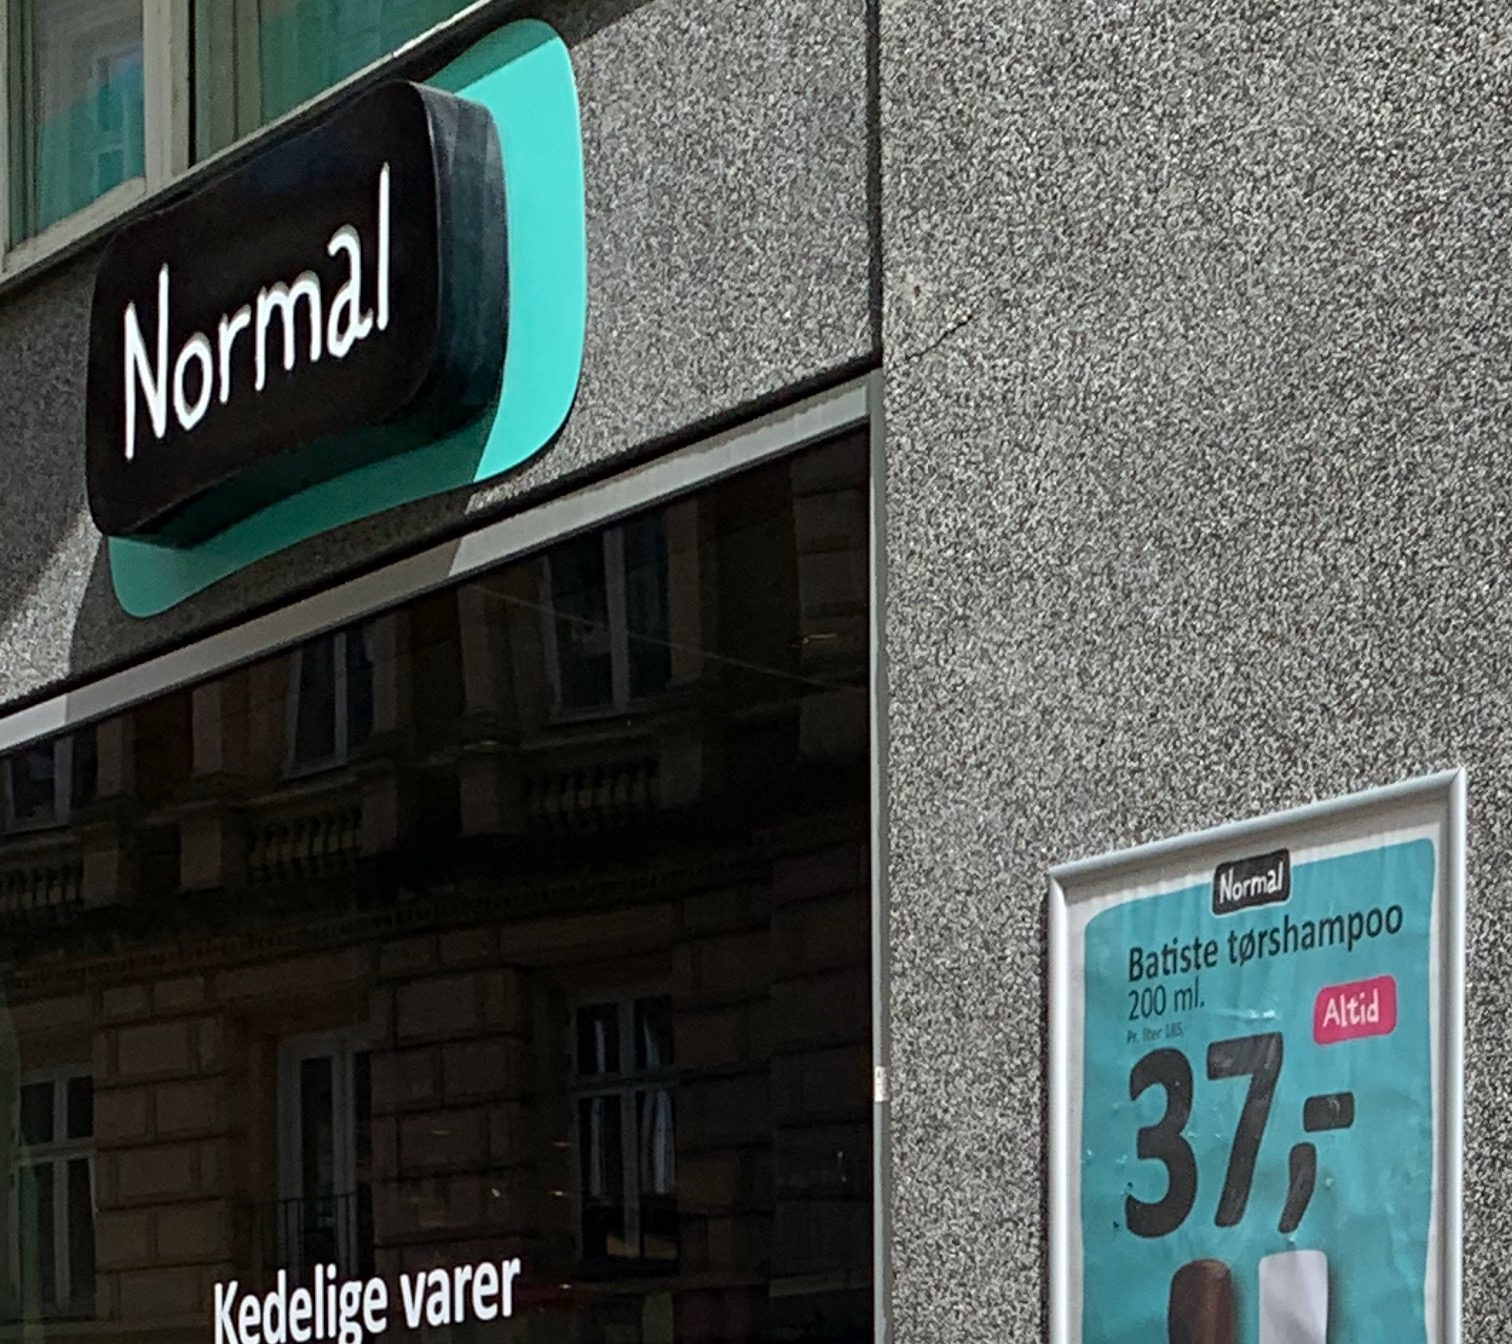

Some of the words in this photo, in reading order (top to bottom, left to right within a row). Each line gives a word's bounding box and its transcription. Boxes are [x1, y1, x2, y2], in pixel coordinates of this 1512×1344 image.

[123, 163, 391, 462] Normal
[1219, 861, 1284, 903] Normal
[1129, 937, 1218, 982] Batiste
[1228, 904, 1403, 966] tørshampoo
[1128, 985, 1166, 1020] 200
[1174, 976, 1205, 1012] ml.
[1322, 990, 1379, 1029] Altid
[400, 1257, 521, 1330] varer
